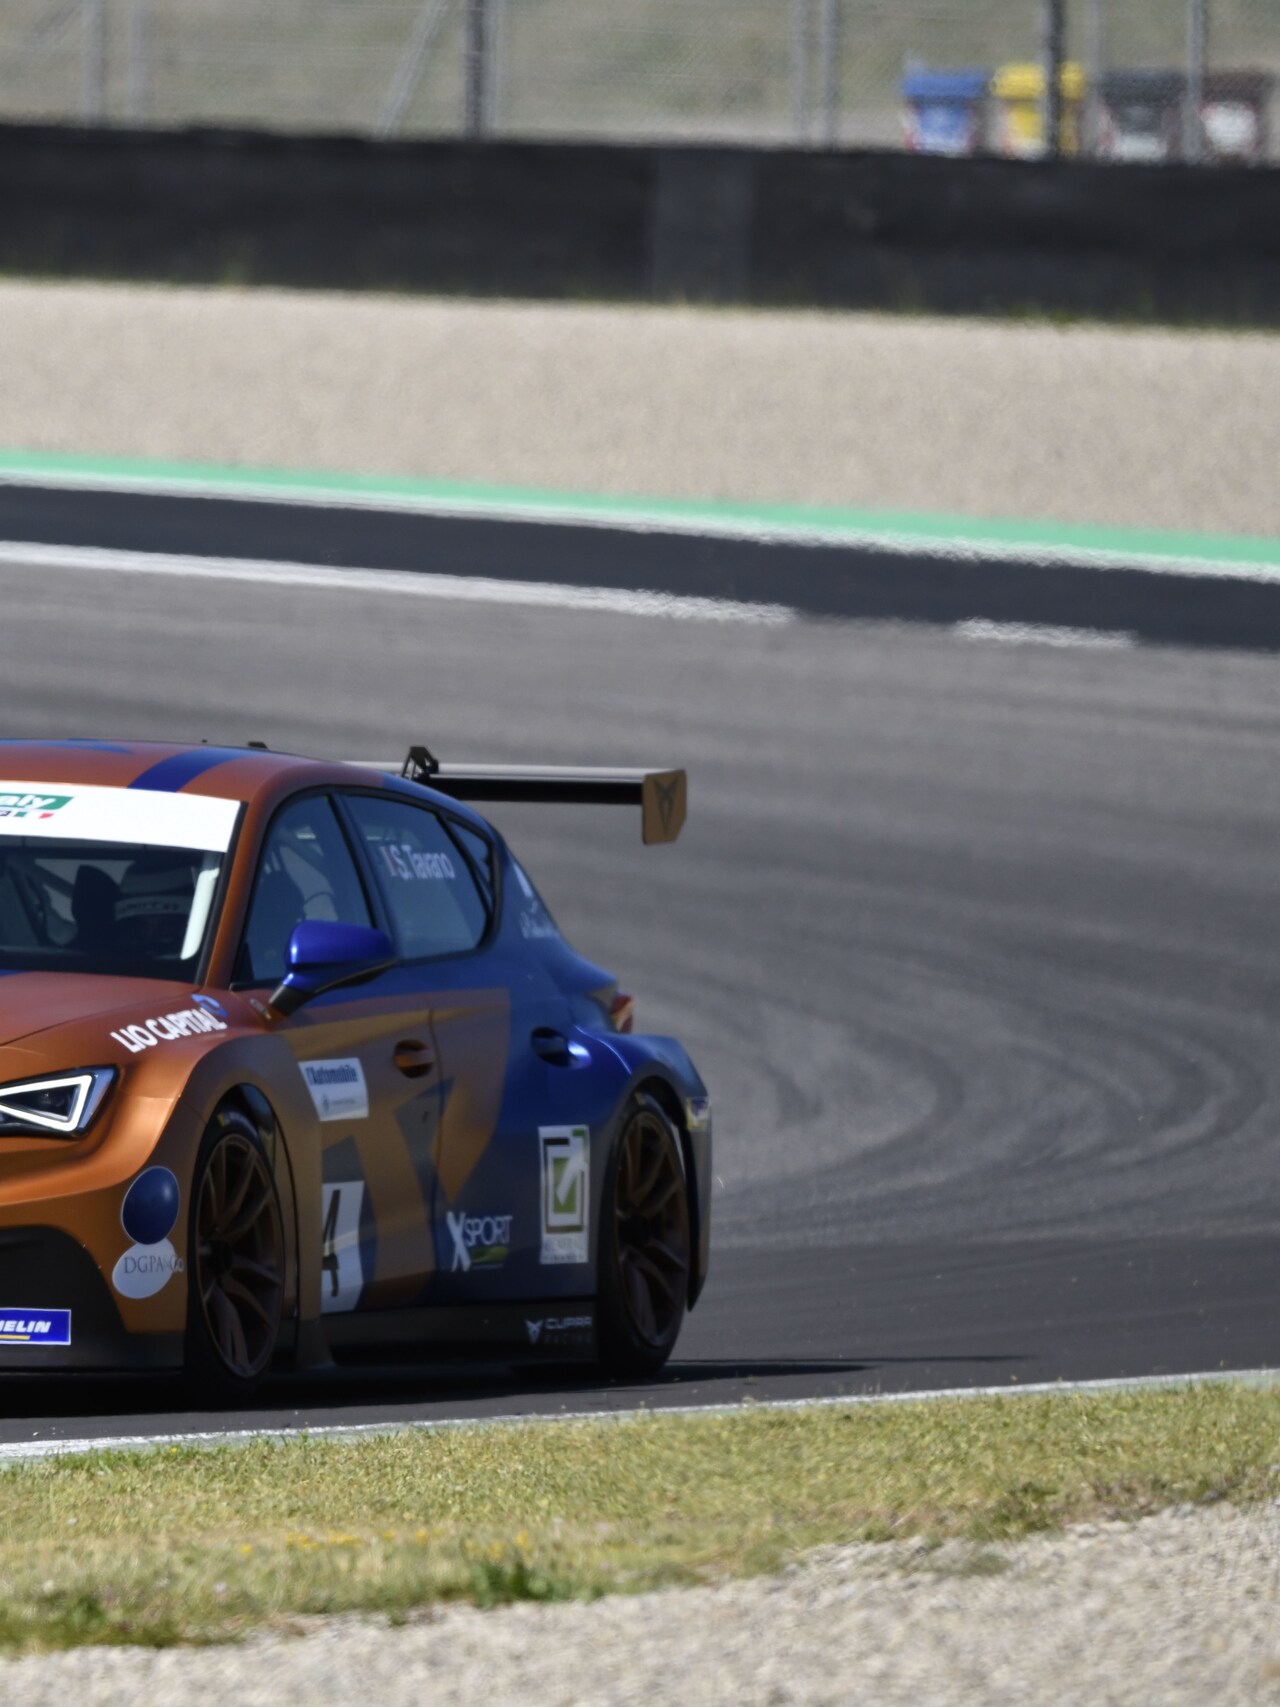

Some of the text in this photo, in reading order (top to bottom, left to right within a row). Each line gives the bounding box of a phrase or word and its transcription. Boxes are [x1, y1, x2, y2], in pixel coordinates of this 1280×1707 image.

[389, 844, 455, 881] S. Tavano
[109, 1006, 228, 1054] LIO CAPITAL
[321, 1188, 341, 1298] 4
[545, 1316, 592, 1330] CUPRA
